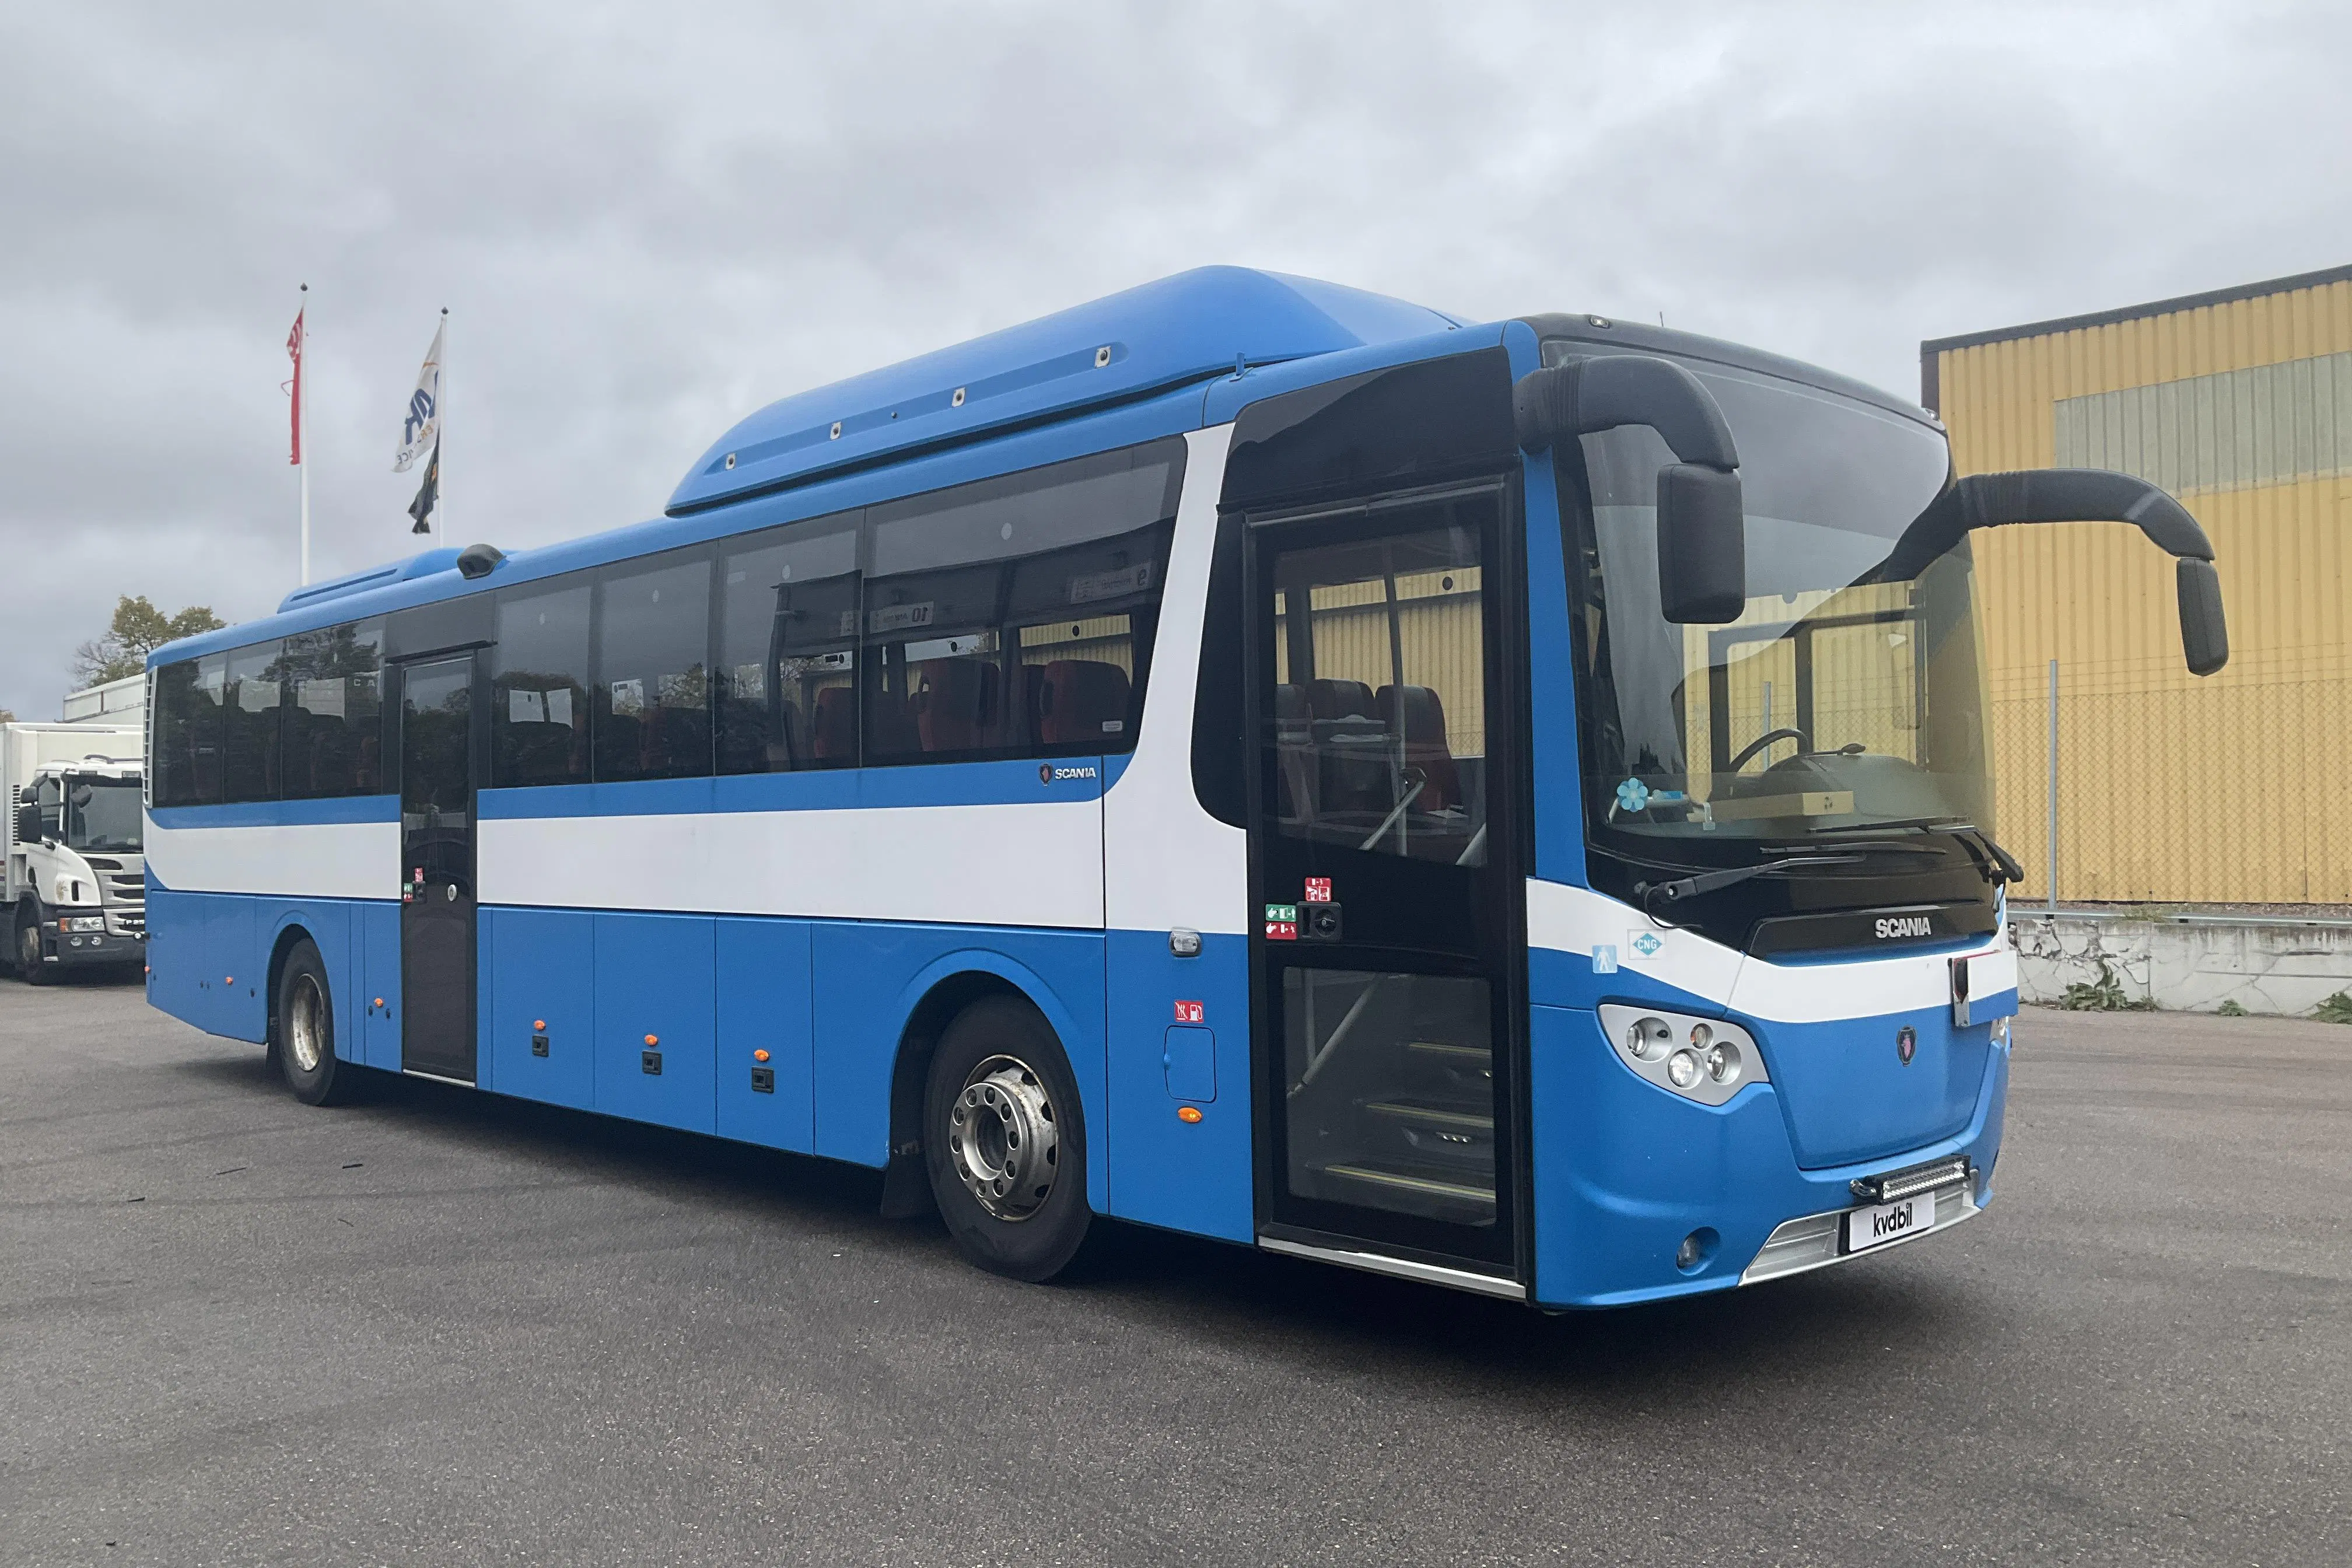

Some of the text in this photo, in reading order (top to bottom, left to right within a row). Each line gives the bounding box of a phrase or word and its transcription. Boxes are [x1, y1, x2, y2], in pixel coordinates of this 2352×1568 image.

[1055, 767, 1097, 779] SCANIA
[1875, 916, 1931, 939] SCANIA
[1637, 939, 1657, 950] CNG
[1873, 1202, 1913, 1238] kvdbil
